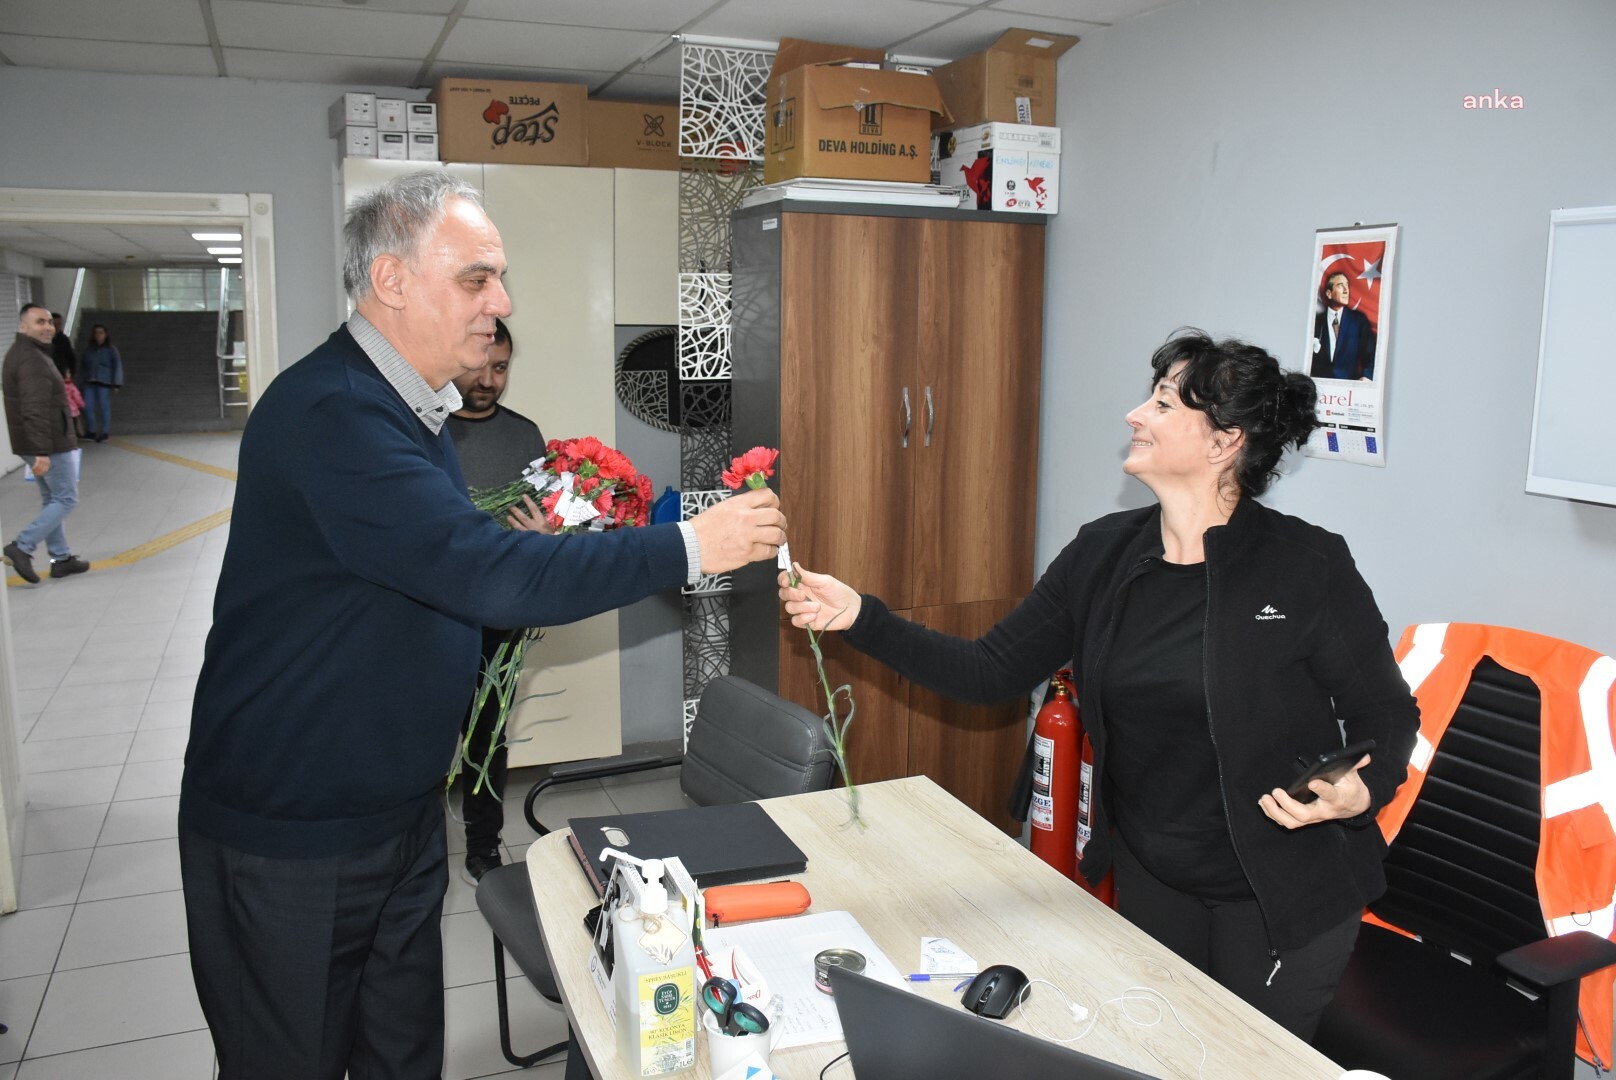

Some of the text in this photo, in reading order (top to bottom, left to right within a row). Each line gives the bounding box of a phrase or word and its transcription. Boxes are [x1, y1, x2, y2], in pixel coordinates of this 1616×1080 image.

[509, 95, 540, 106] PEÇETE
[492, 115, 559, 147] Step
[818, 139, 918, 160] DEVA HOLDİNG A.Ş.
[1318, 390, 1352, 407] arel
[1033, 796, 1051, 807] ZGE
[1078, 826, 1090, 838] GE
